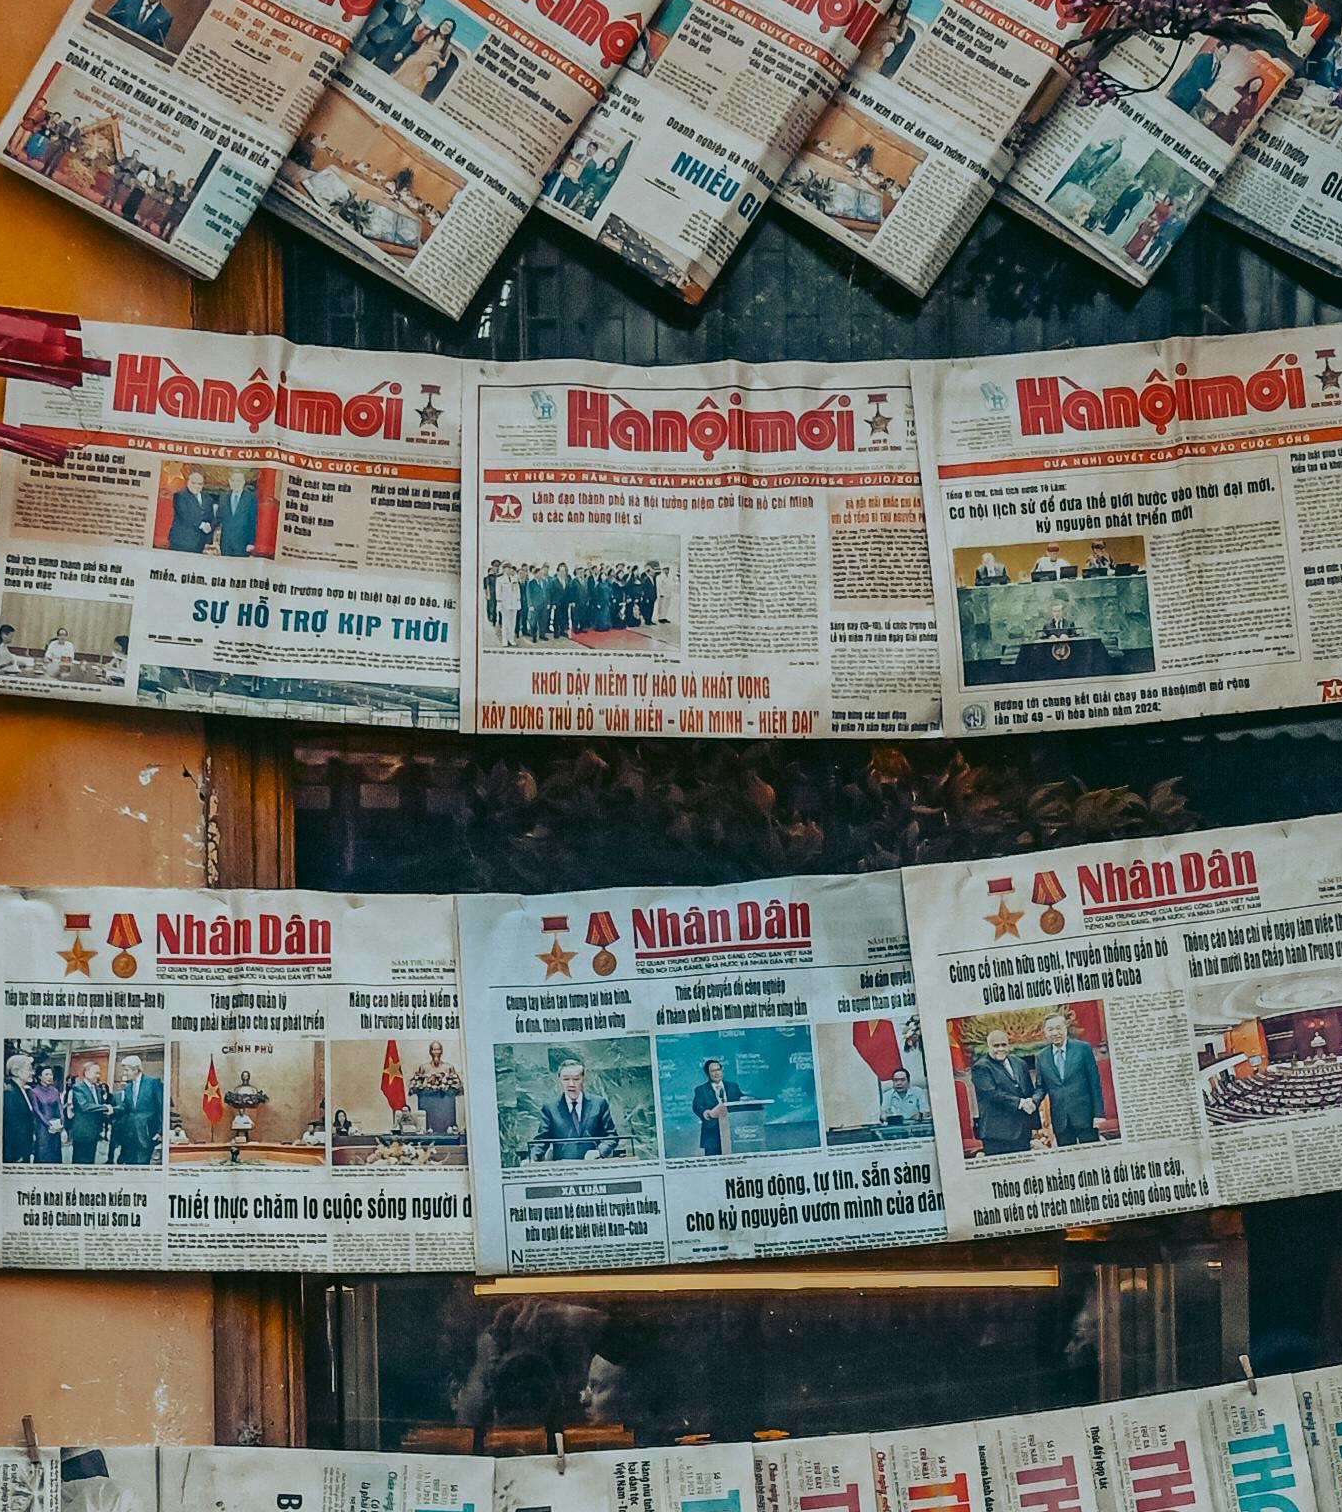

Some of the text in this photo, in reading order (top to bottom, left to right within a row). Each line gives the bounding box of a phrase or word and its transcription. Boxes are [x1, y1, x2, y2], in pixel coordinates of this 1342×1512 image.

[948, 506, 964, 519] Cơ
[968, 503, 988, 518] hội
[992, 502, 1016, 519] lịch
[1020, 498, 1035, 514] sử
[1039, 494, 1055, 513] để
[1059, 497, 1082, 511] đưa
[1086, 491, 1106, 509] thế
[1110, 492, 1133, 509] giới
[1137, 490, 1167, 506] bước
[1171, 486, 1192, 502] vào
[1195, 483, 1218, 499] thời
[1223, 481, 1242, 498] đại
[192, 599, 448, 642] SỰ HỖ TRỢ KỊP THỜI
[531, 670, 561, 694] KHƠI
[566, 667, 590, 700] DẬY
[652, 669, 676, 697] HÀO
[681, 670, 696, 698] VÀ
[702, 671, 732, 699] KHÁT
[737, 675, 770, 704] VỌNG
[1076, 848, 1257, 905] Nhân Dân
[156, 913, 330, 955] Nhân Dân
[631, 901, 810, 949] Nhân Dân
[949, 960, 976, 983] Củng
[992, 957, 1014, 977] tình
[1015, 953, 1035, 974] hữu
[1065, 947, 1101, 968] truyền
[1102, 941, 1132, 963] thống
[1154, 936, 1168, 957] bó
[724, 1160, 930, 1199] Năng động, tự tin, sẵn sàng
[168, 1188, 457, 1224] Thiết thực chăm lo cuộc sống người
[685, 1210, 714, 1232] cho
[718, 1204, 737, 1231] kỷ
[741, 1202, 798, 1228] nguyên
[801, 1201, 840, 1222] vươn
[843, 1195, 883, 1219] mình
[886, 1189, 914, 1215] của
